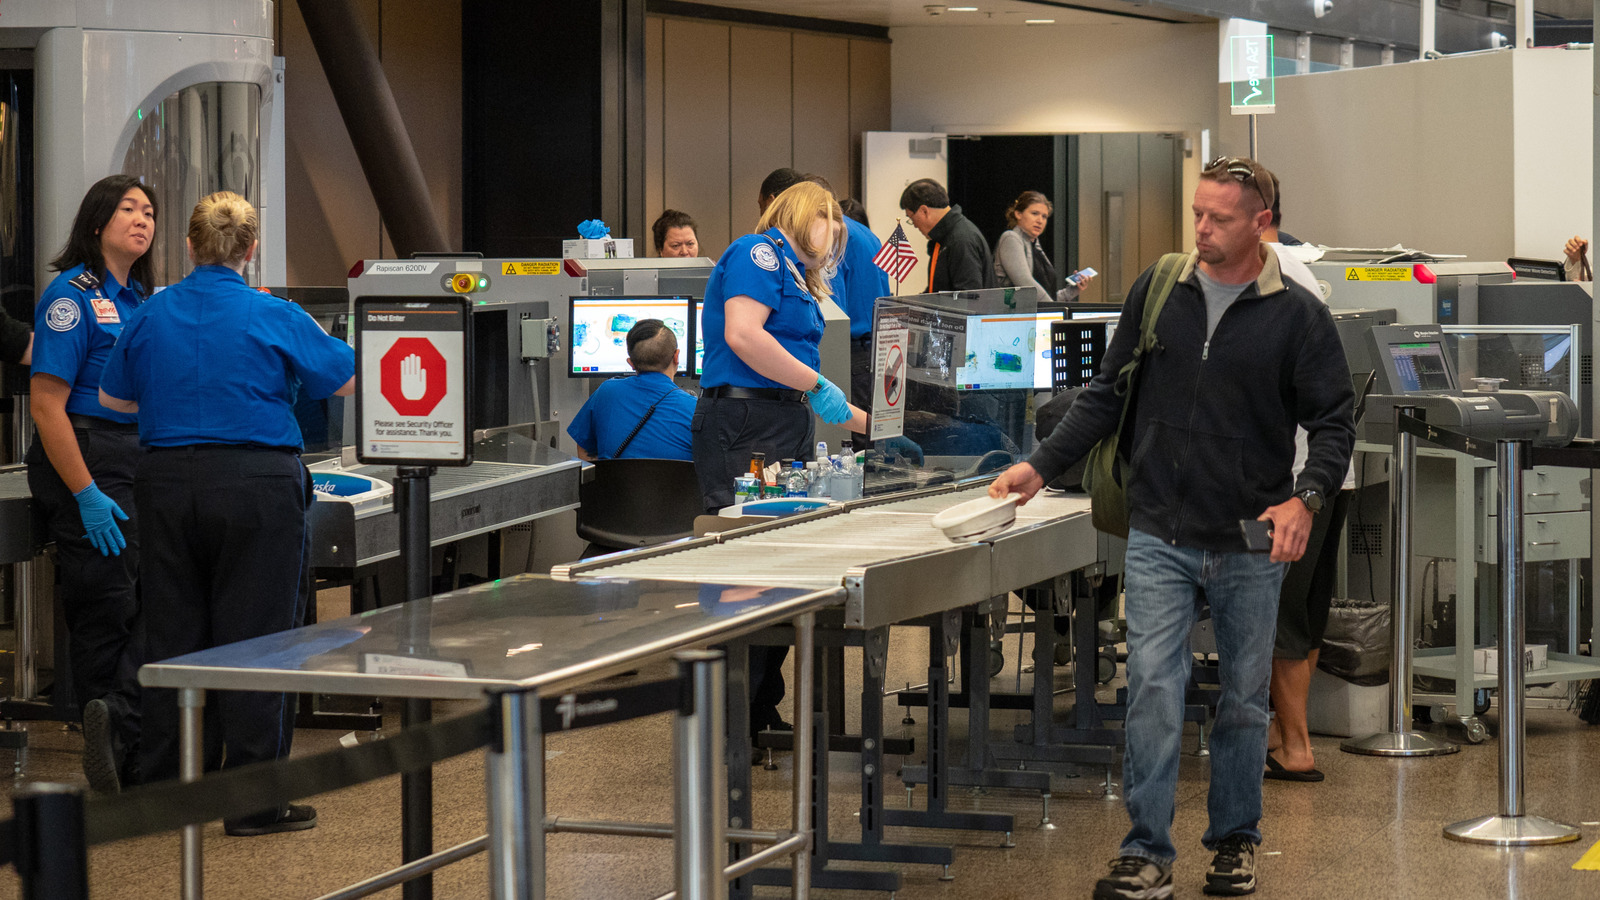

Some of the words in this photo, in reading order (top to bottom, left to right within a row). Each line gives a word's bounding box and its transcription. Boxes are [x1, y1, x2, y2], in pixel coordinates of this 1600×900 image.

[376, 264, 404, 273] Rapiscan
[405, 264, 427, 272] 620DV
[367, 314, 377, 322] Do
[377, 314, 388, 322] Not
[374, 420, 394, 428] Please
[407, 420, 432, 429] Security
[433, 421, 454, 429] Officer
[419, 429, 438, 437] Thank
[313, 480, 336, 493] aska
